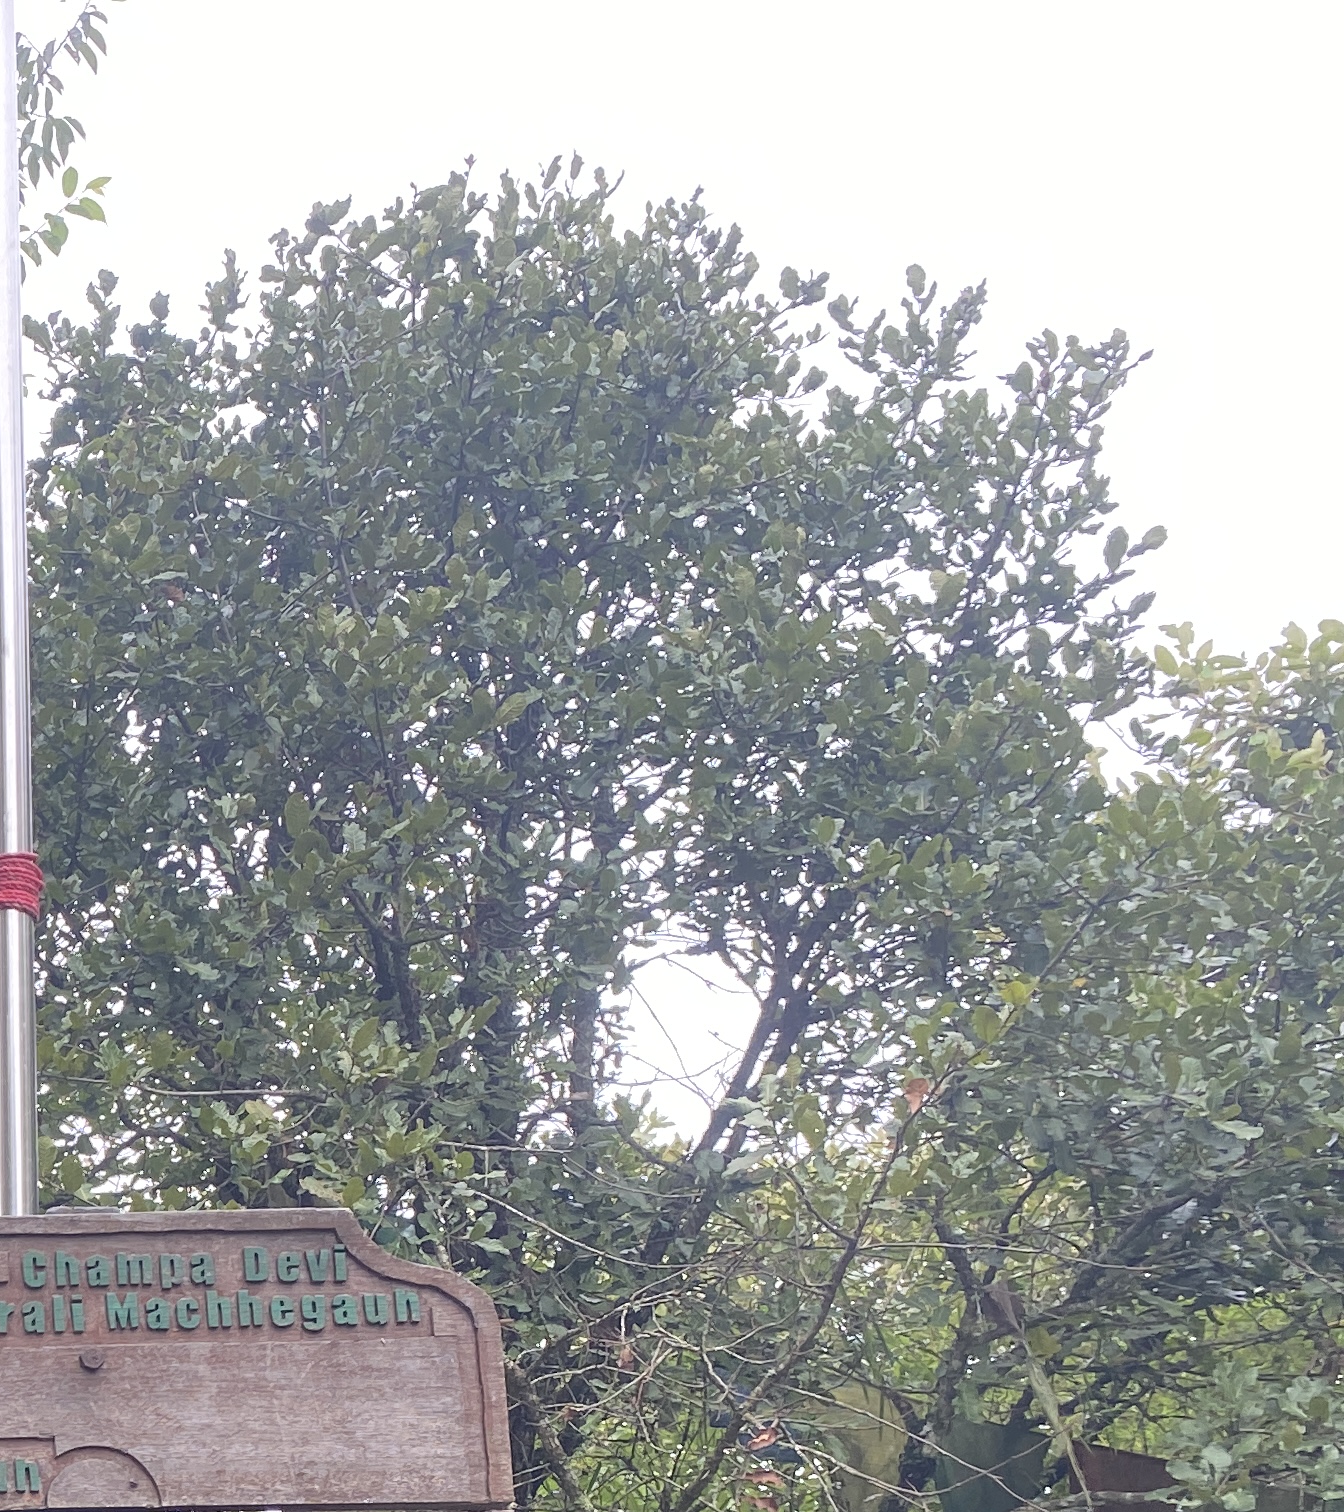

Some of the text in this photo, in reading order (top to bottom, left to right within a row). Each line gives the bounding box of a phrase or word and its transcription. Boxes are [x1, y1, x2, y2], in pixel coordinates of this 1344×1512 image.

[22, 1243, 348, 1289] Champa Devi
[105, 1287, 421, 1332] Machhegaun
